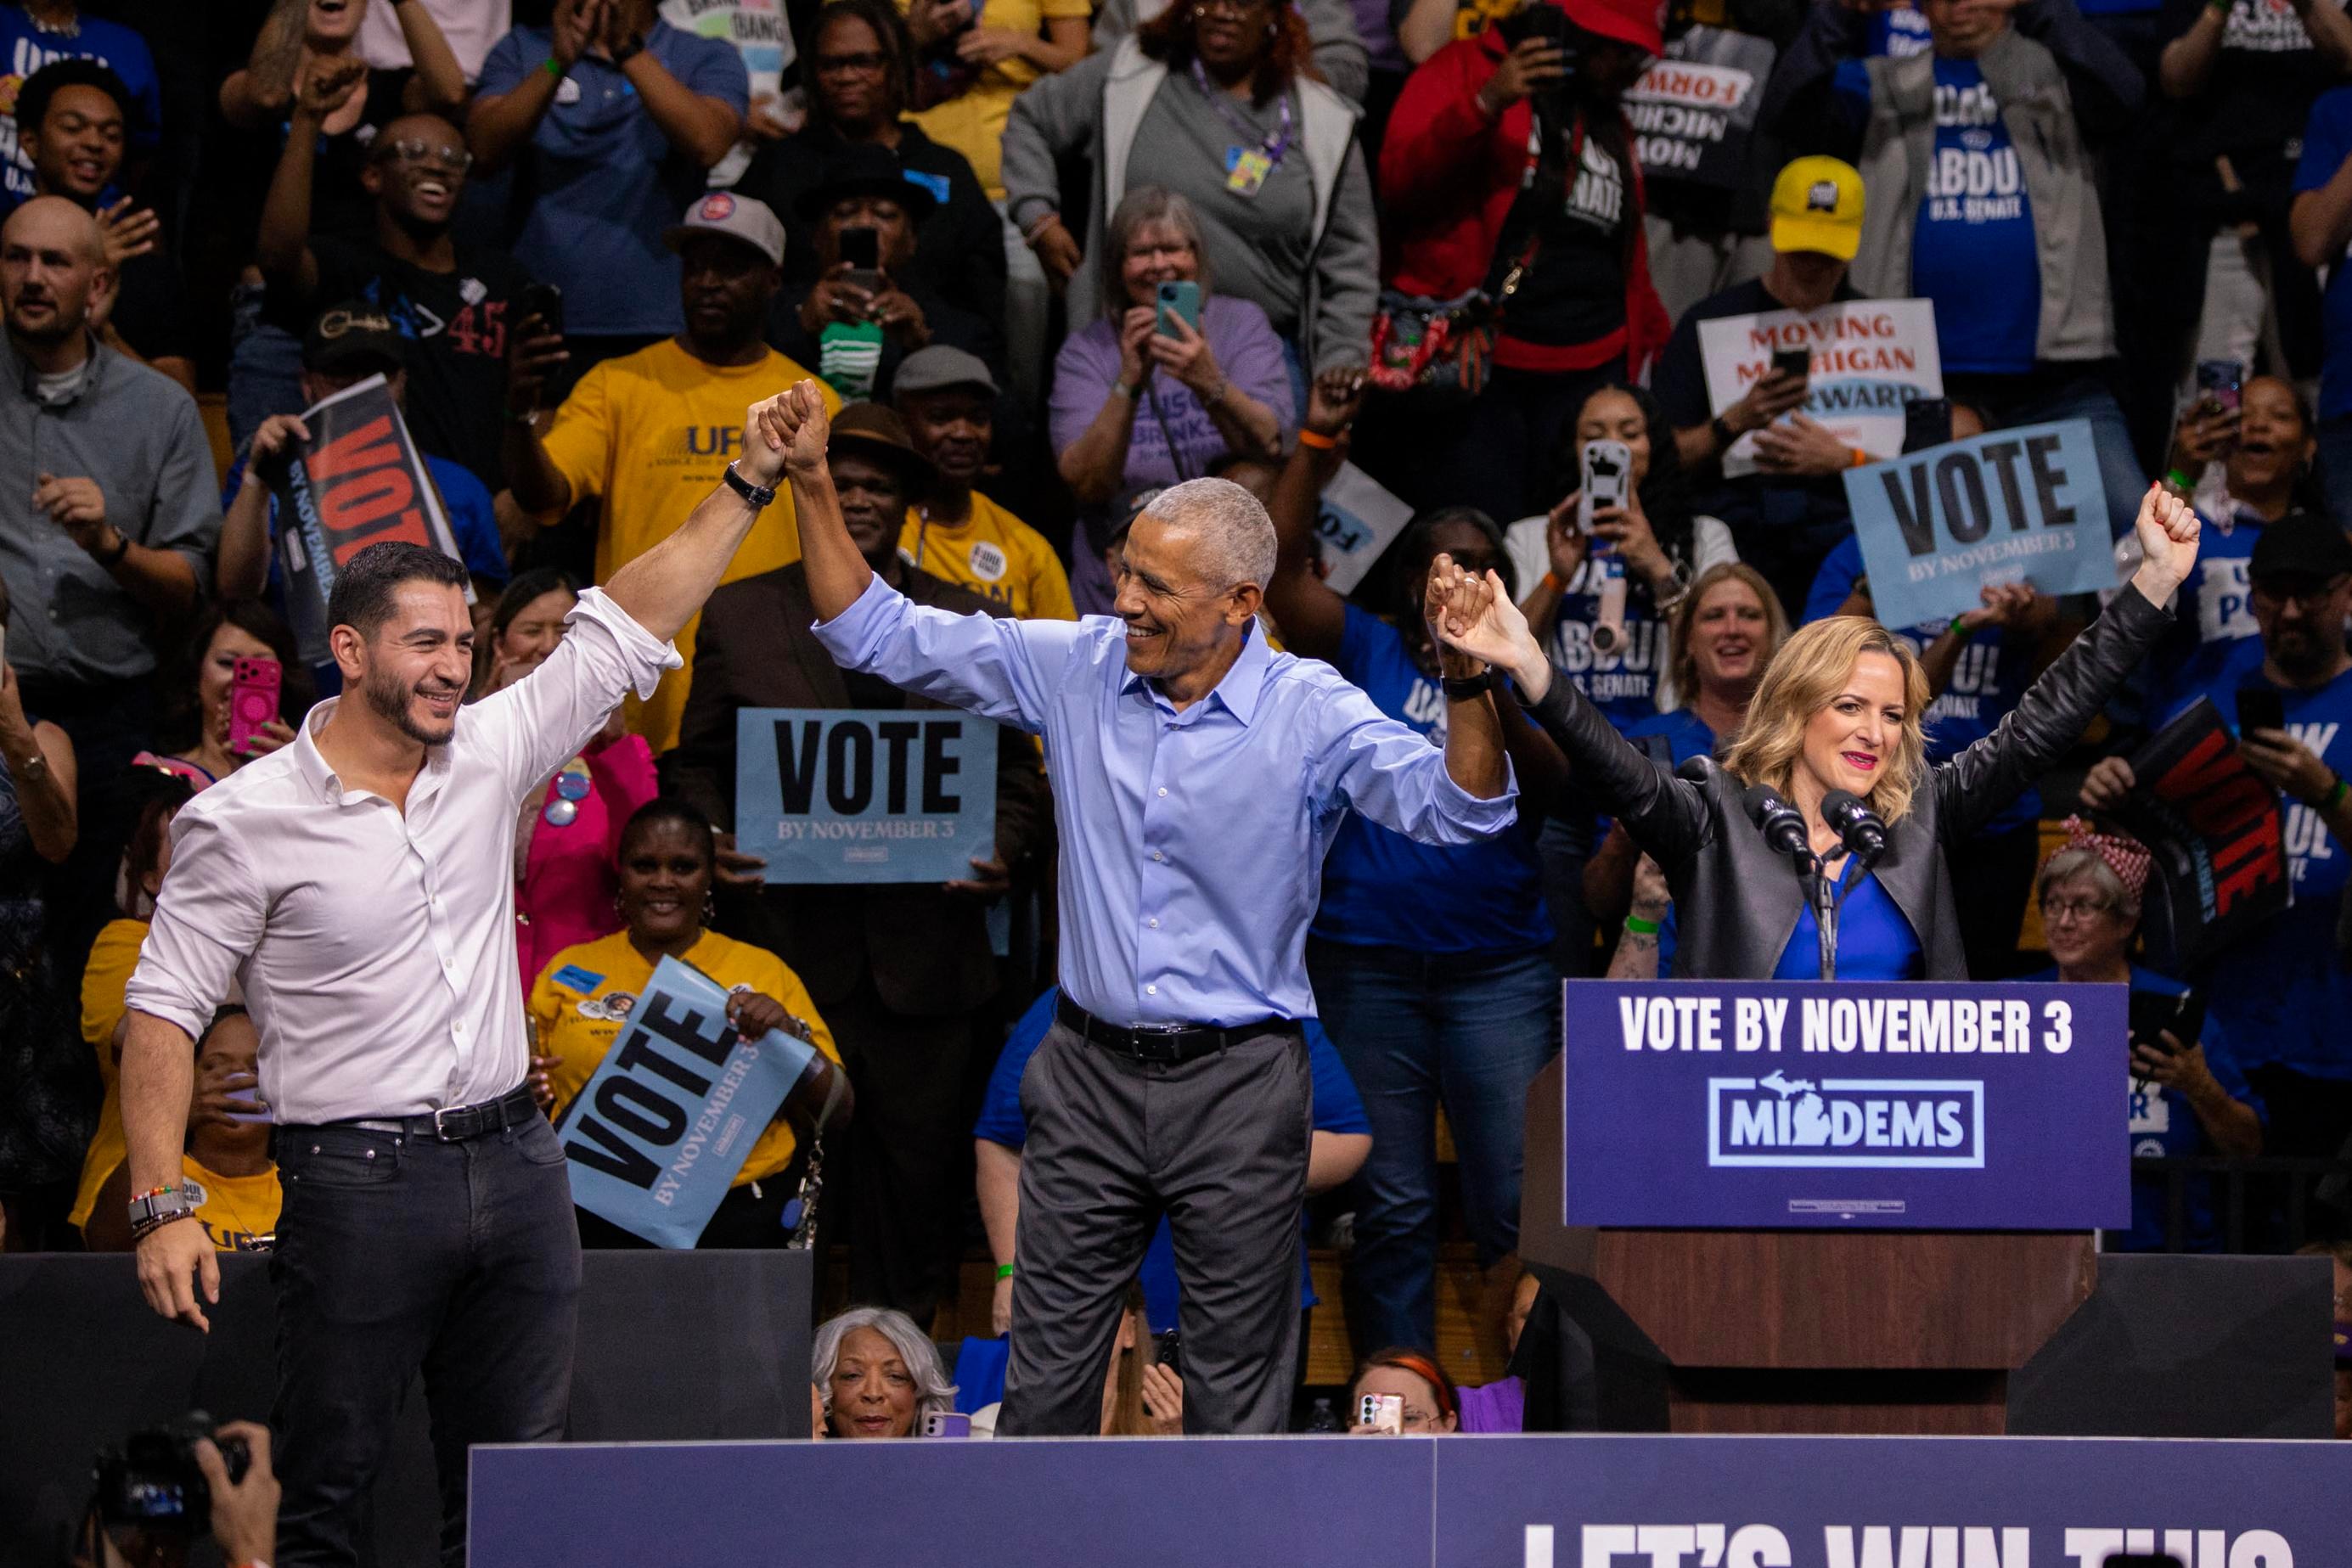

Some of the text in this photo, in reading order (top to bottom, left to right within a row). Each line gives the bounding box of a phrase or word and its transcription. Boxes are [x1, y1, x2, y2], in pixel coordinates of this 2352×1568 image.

[1962, 196, 2022, 225] SENATE
[447, 300, 508, 360] 45
[1748, 314, 1895, 350] MOVING
[1737, 346, 1916, 384] MHIGAN
[289, 458, 308, 490] BY
[306, 413, 430, 569] VOT
[1879, 434, 2078, 558] VOTE
[1907, 561, 1938, 584] BY
[1941, 533, 2062, 575] NOVEMBER
[2064, 530, 2077, 552] 3
[1590, 673, 1655, 703] SENATE
[774, 720, 962, 816] VOTE
[777, 820, 955, 840] BY NOVEMBER 3
[2153, 727, 2282, 919] VOTE
[1619, 997, 2073, 1054] VOTE BY NOVEMBER 3
[563, 989, 739, 1191] VOTE
[654, 1173, 680, 1207] BY
[672, 1059, 752, 1177] NOVEMBER
[740, 1044, 761, 1060] 3
[1730, 1099, 1965, 1149] MI DEMS
